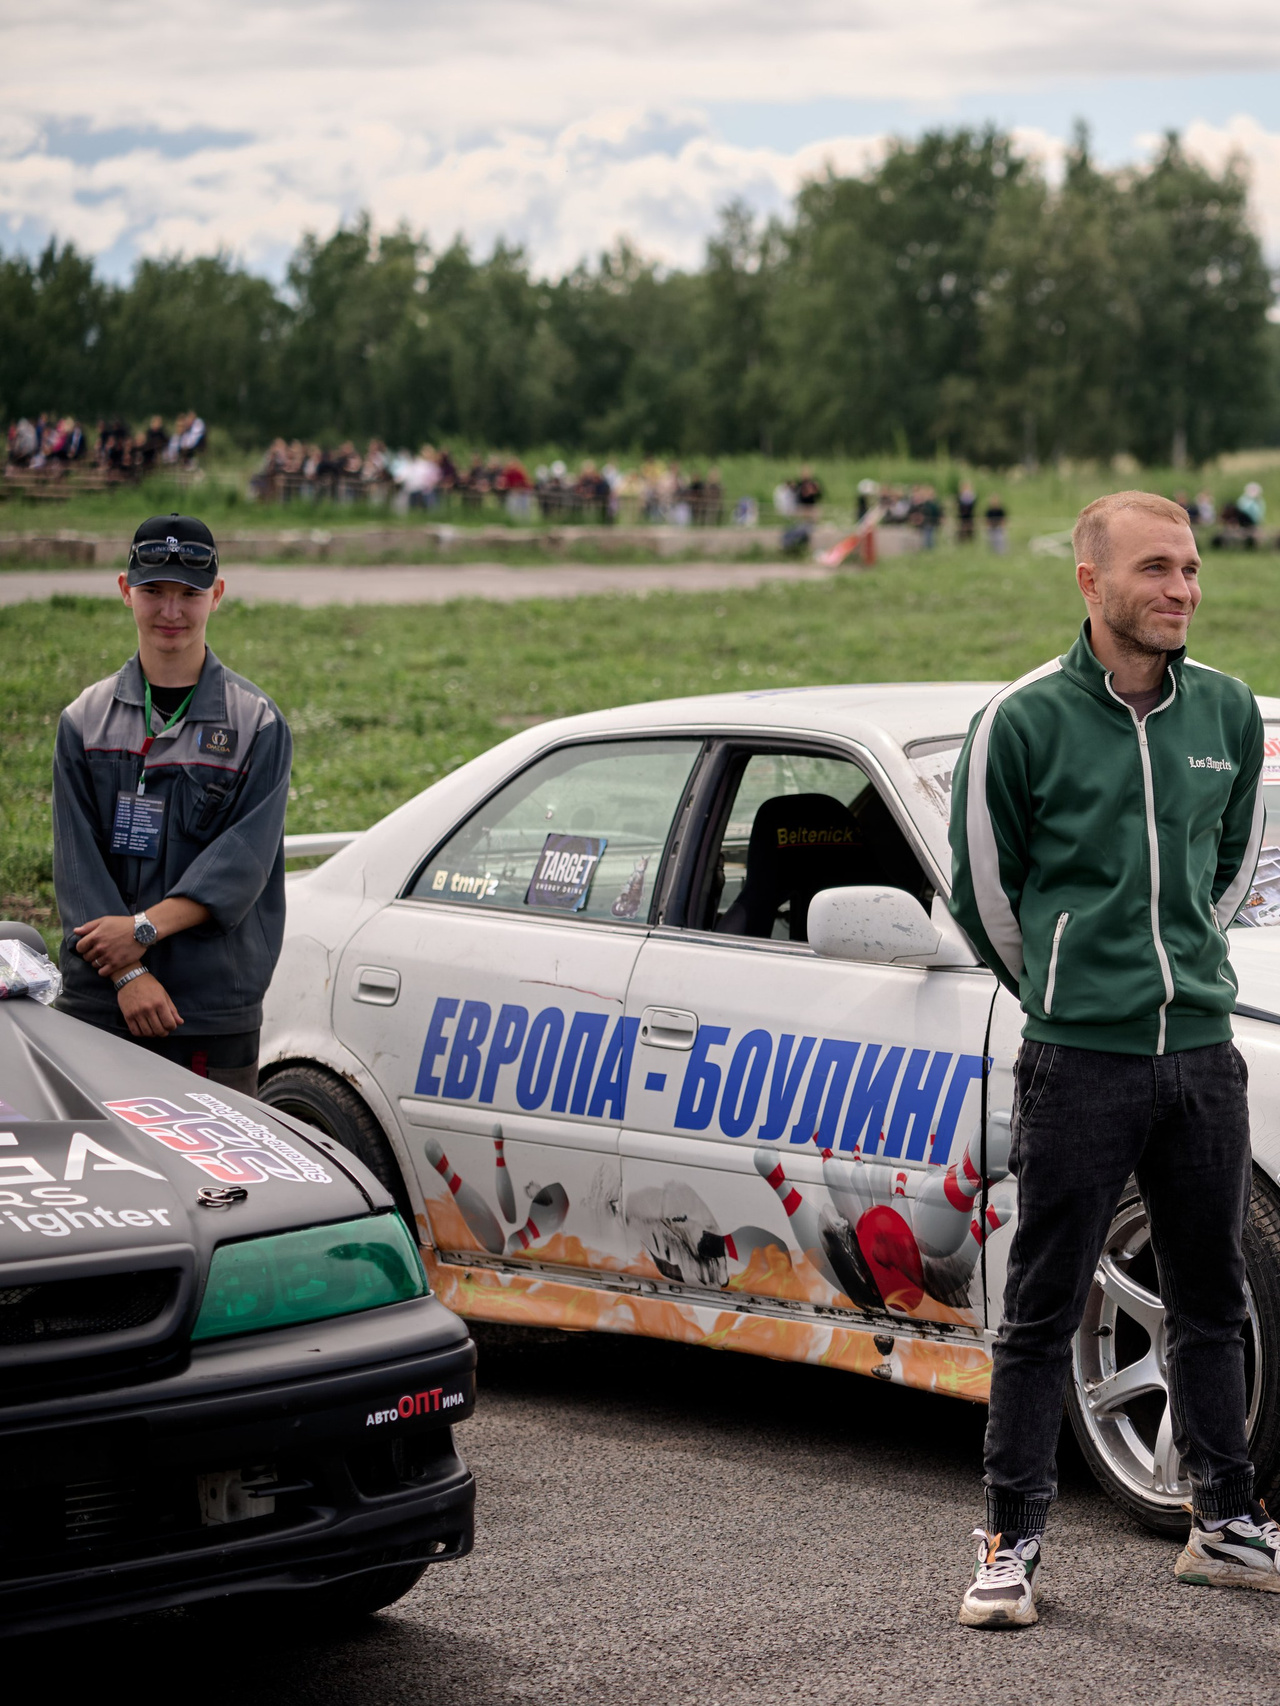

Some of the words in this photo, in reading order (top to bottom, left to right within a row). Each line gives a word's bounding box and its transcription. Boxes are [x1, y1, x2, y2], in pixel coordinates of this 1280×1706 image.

[1188, 756, 1206, 769] Los
[1206, 756, 1232, 772] Angeles
[539, 850, 597, 885] TARGET
[451, 871, 499, 900] tmrjz
[535, 883, 560, 892] ENERGY
[561, 885, 583, 895] DRINK
[414, 996, 641, 1121] ЕВРОПА
[674, 1024, 995, 1166] БОУЛИНГ
[101, 1096, 307, 1184] SSP
[0, 1206, 172, 1237] ighter
